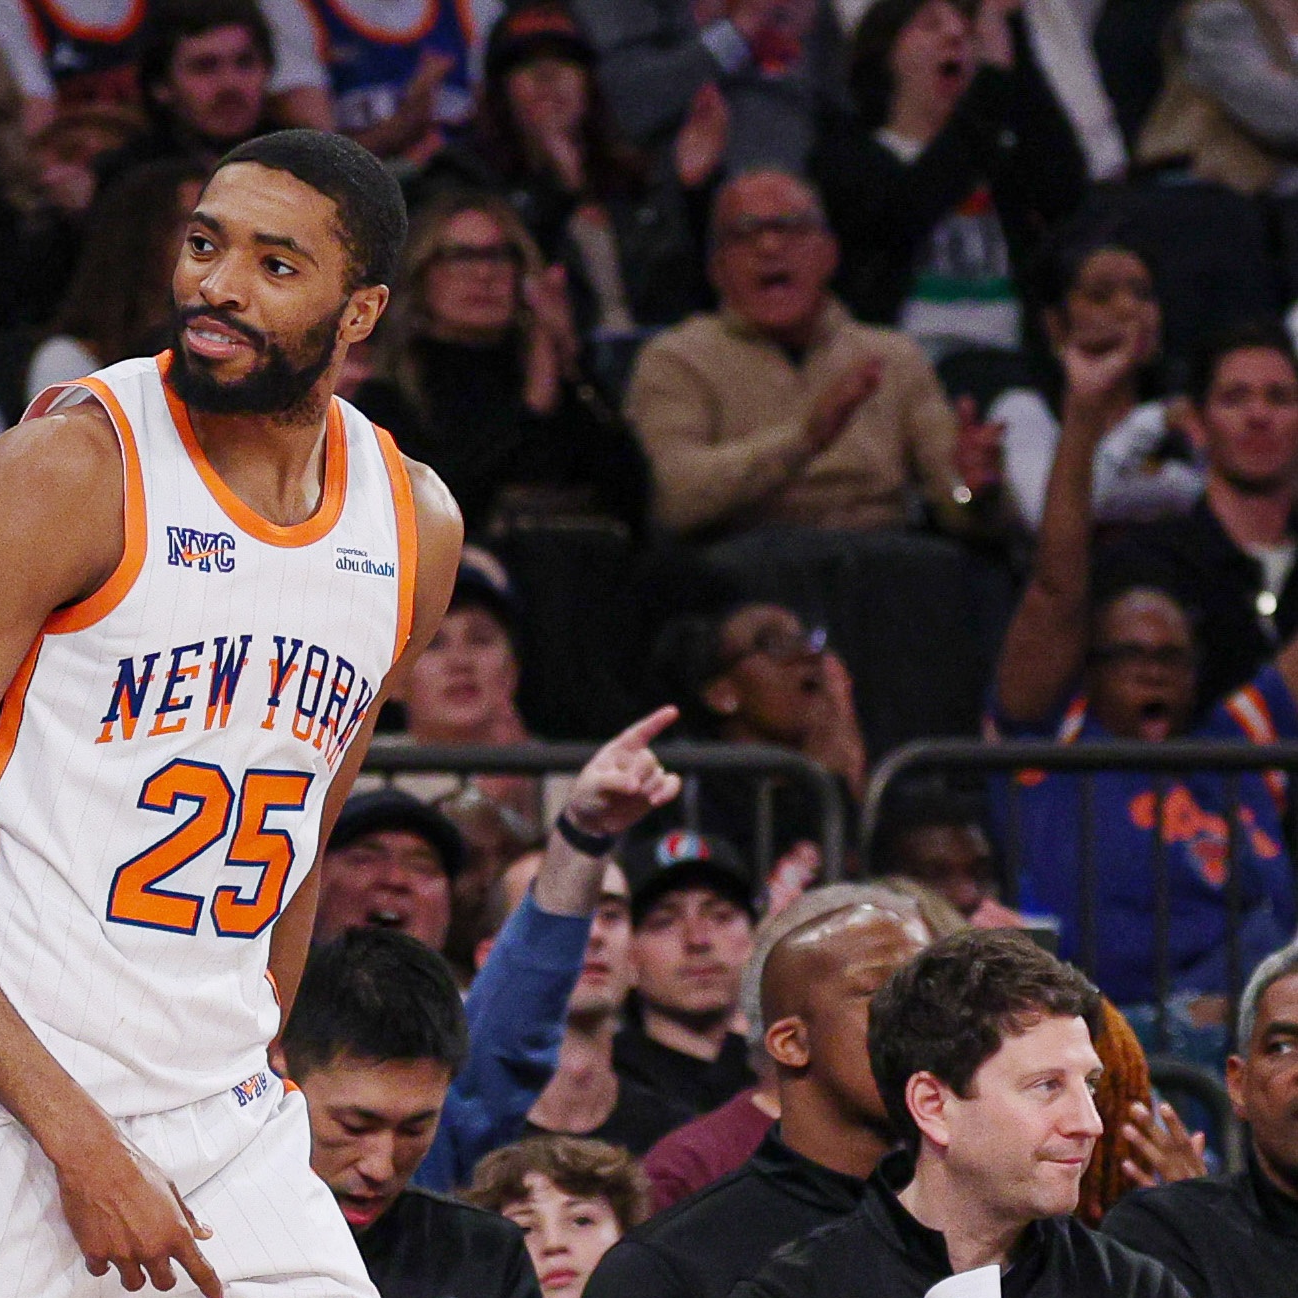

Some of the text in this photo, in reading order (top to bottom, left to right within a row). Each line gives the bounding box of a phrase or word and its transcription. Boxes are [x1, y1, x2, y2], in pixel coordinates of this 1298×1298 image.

[166, 525, 236, 573] NYC
[336, 556, 395, 578] abu dhabi
[95, 634, 373, 771] NEW YORK
[106, 757, 316, 939] 25
